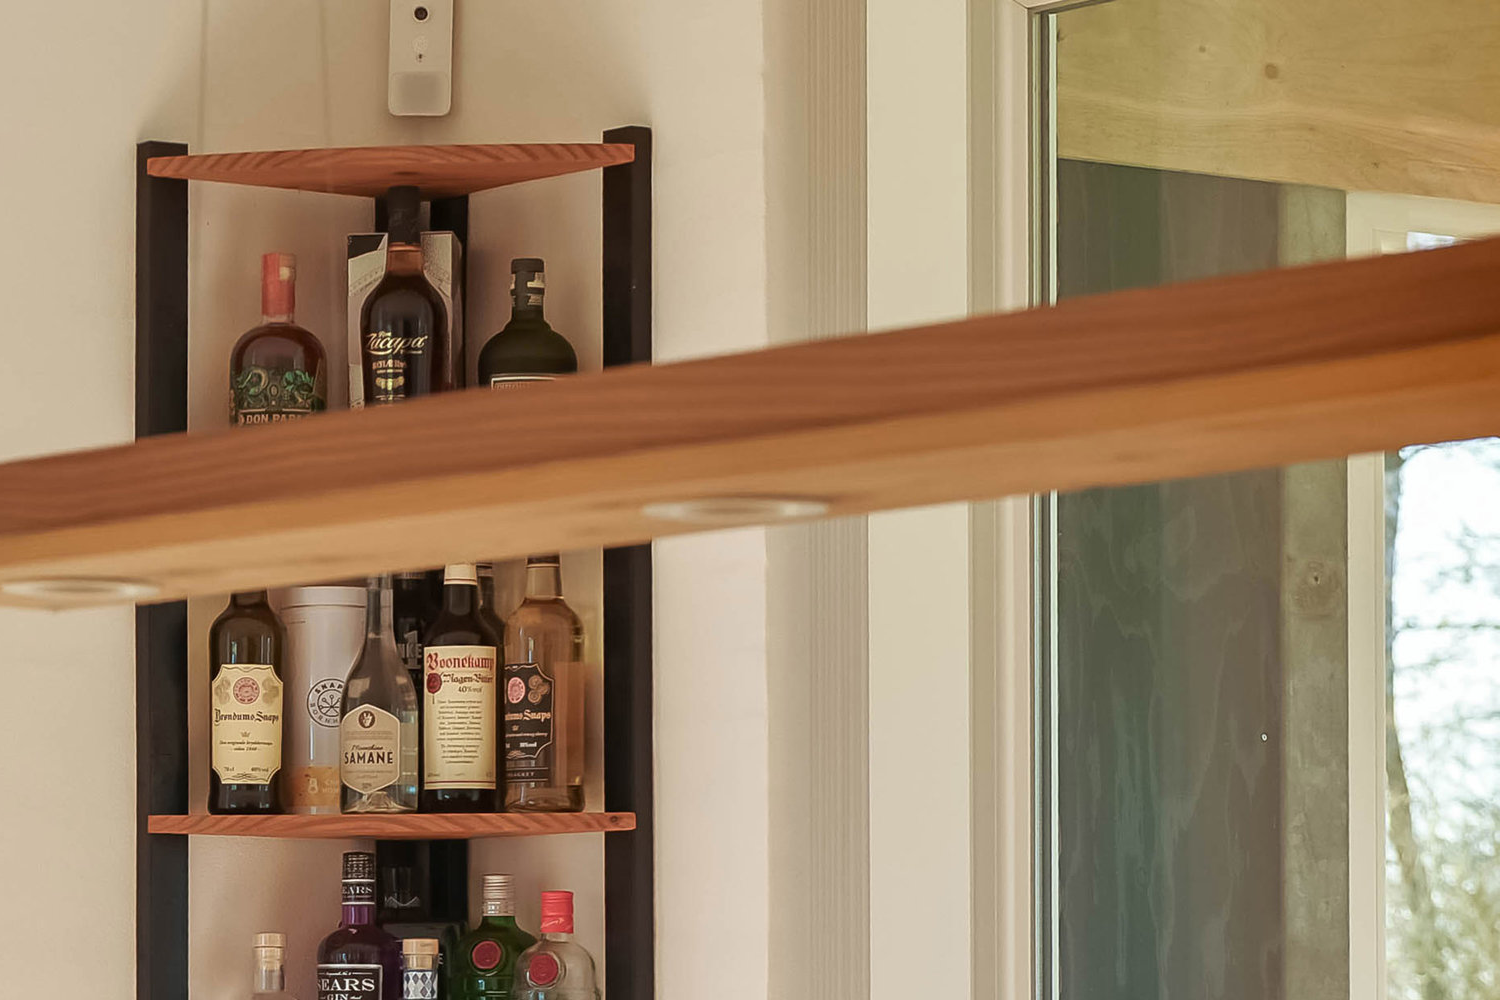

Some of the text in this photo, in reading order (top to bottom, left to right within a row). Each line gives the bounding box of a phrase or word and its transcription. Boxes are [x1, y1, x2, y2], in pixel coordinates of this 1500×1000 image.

[246, 414, 269, 424] DON
[427, 652, 494, 671] Boonekamp
[314, 682, 344, 694] SNAP
[523, 709, 551, 722] Snaps
[344, 752, 393, 765] SAMANE
[342, 885, 372, 895] EARS
[327, 993, 349, 1000] GIN
